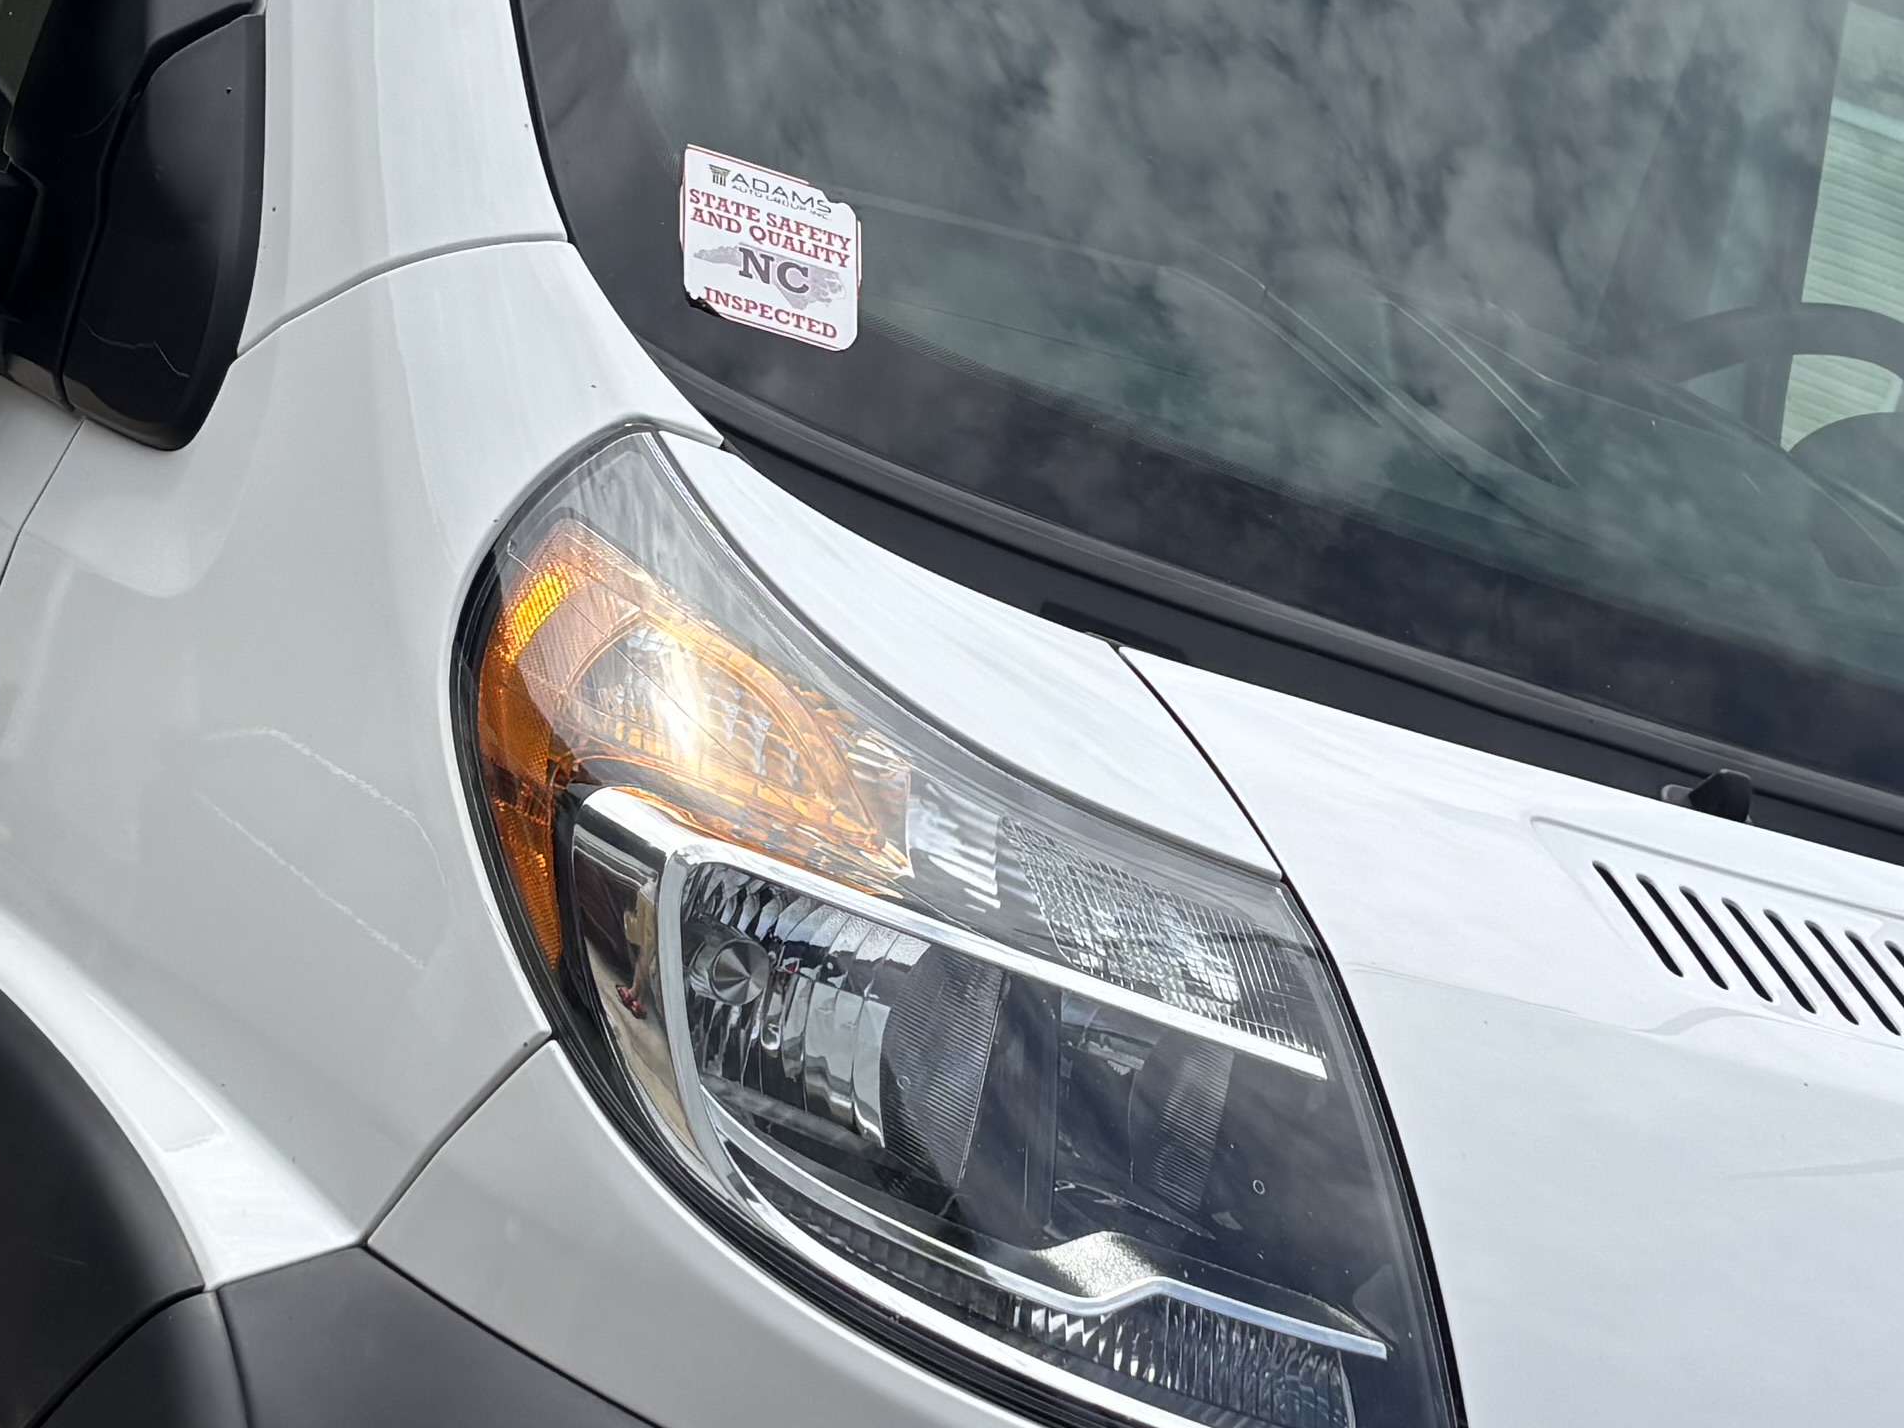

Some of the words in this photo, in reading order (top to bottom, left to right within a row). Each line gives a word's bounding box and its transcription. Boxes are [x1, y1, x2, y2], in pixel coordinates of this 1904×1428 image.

[689, 188, 760, 223] STATE
[766, 212, 851, 251] SAFETY
[731, 173, 832, 214] ADAMS
[690, 207, 742, 234] AND
[749, 225, 850, 268] QUALITY
[738, 247, 810, 294] NC
[703, 286, 838, 339] INSPECTED
